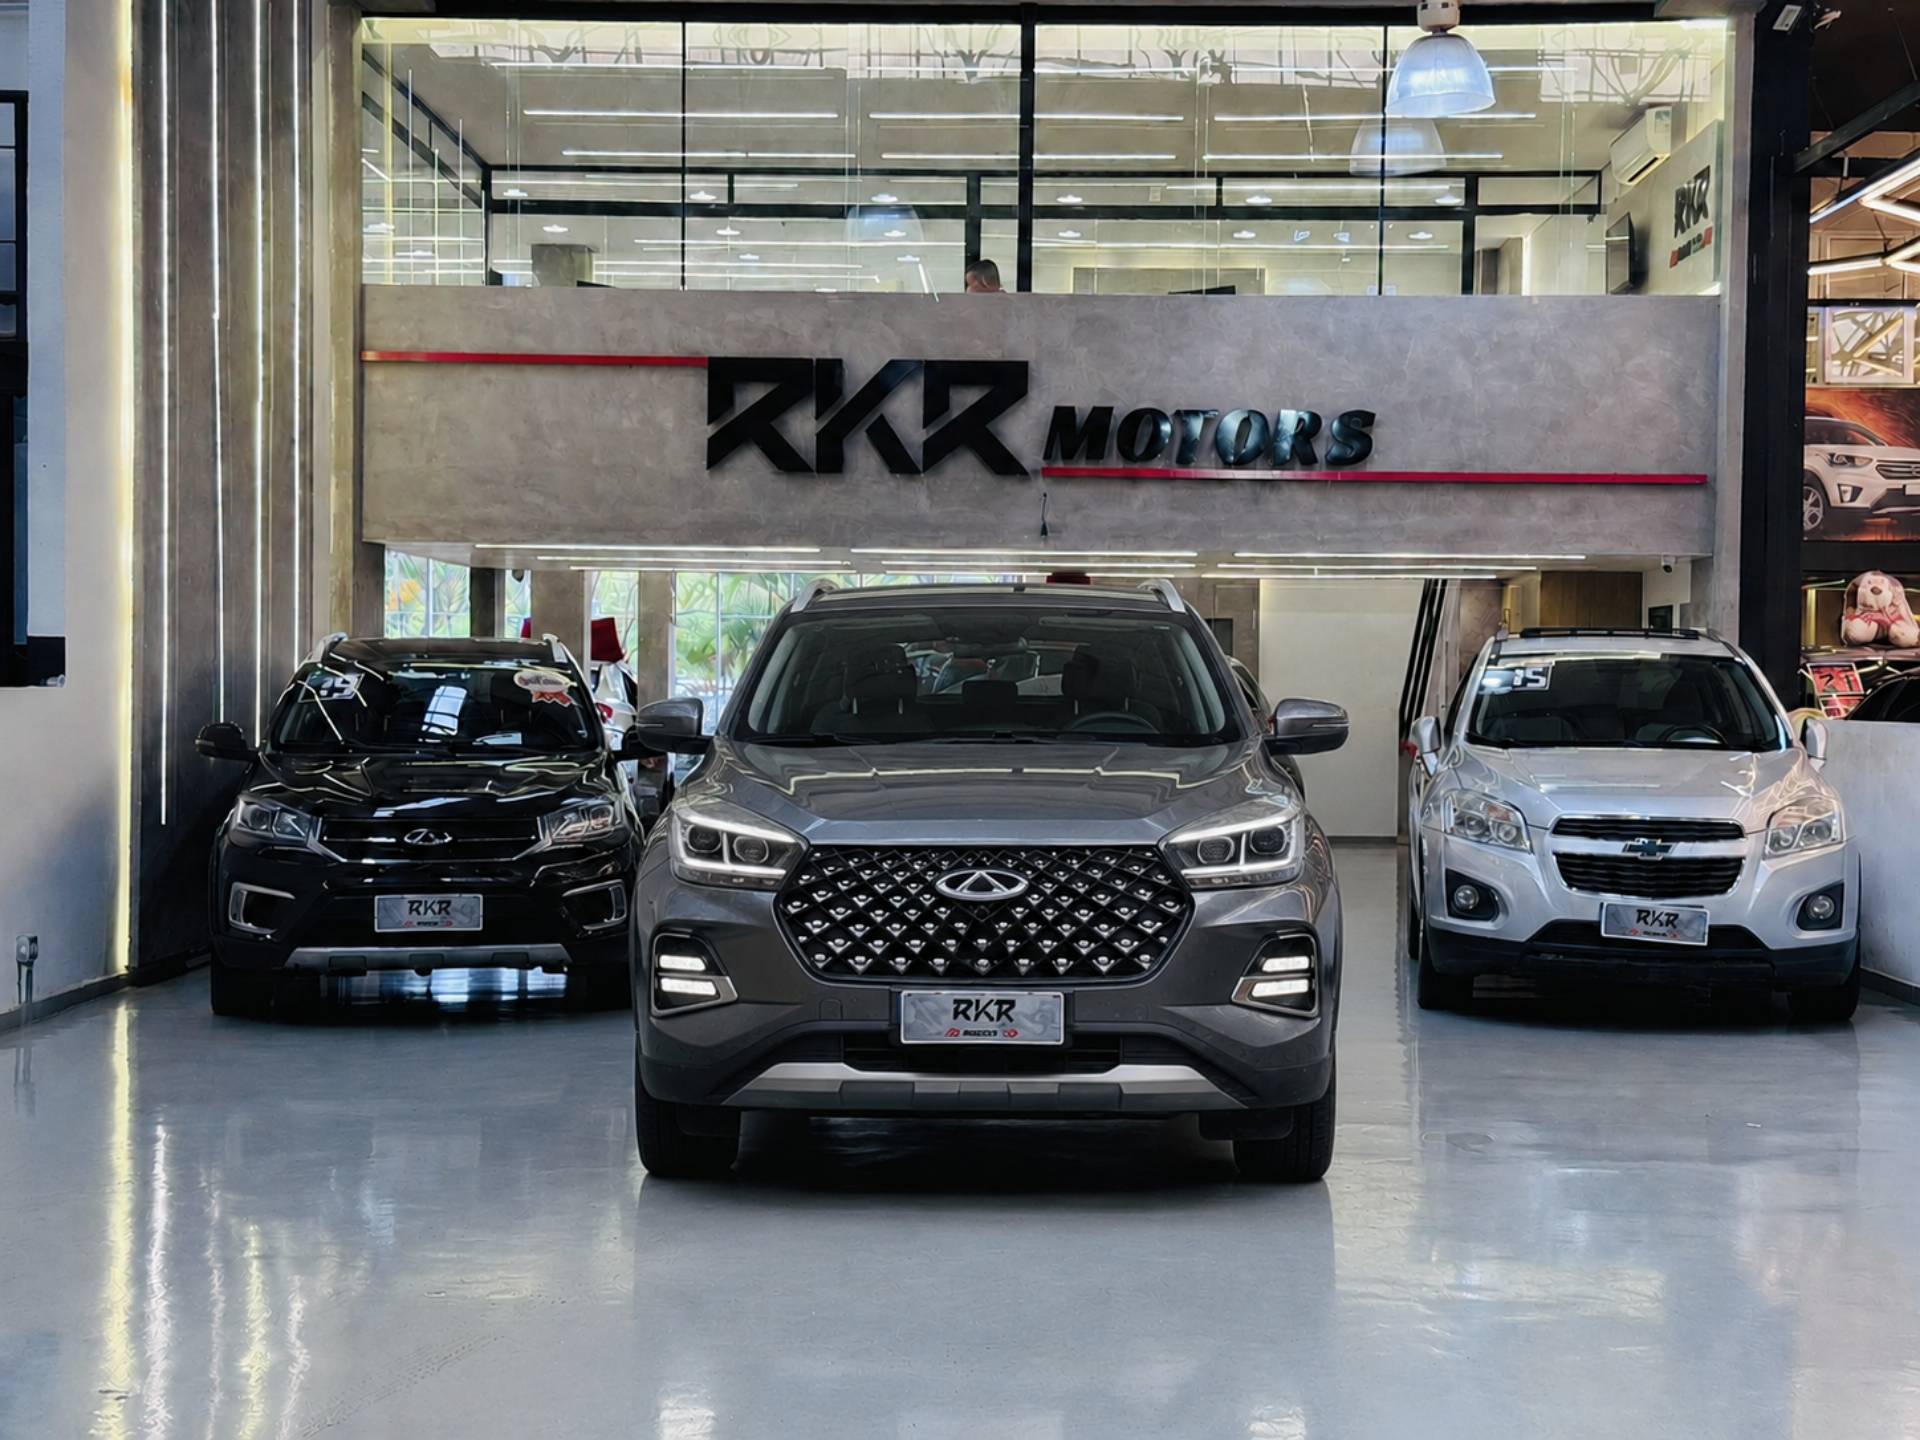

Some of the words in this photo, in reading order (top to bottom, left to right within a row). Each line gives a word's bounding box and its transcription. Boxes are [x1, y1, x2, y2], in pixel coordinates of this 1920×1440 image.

[706, 357, 1030, 475] RKR
[1043, 406, 1376, 466] MOTORS
[407, 899, 452, 916] RKR
[1635, 908, 1680, 929] RKR
[952, 998, 1017, 1023] RKR
